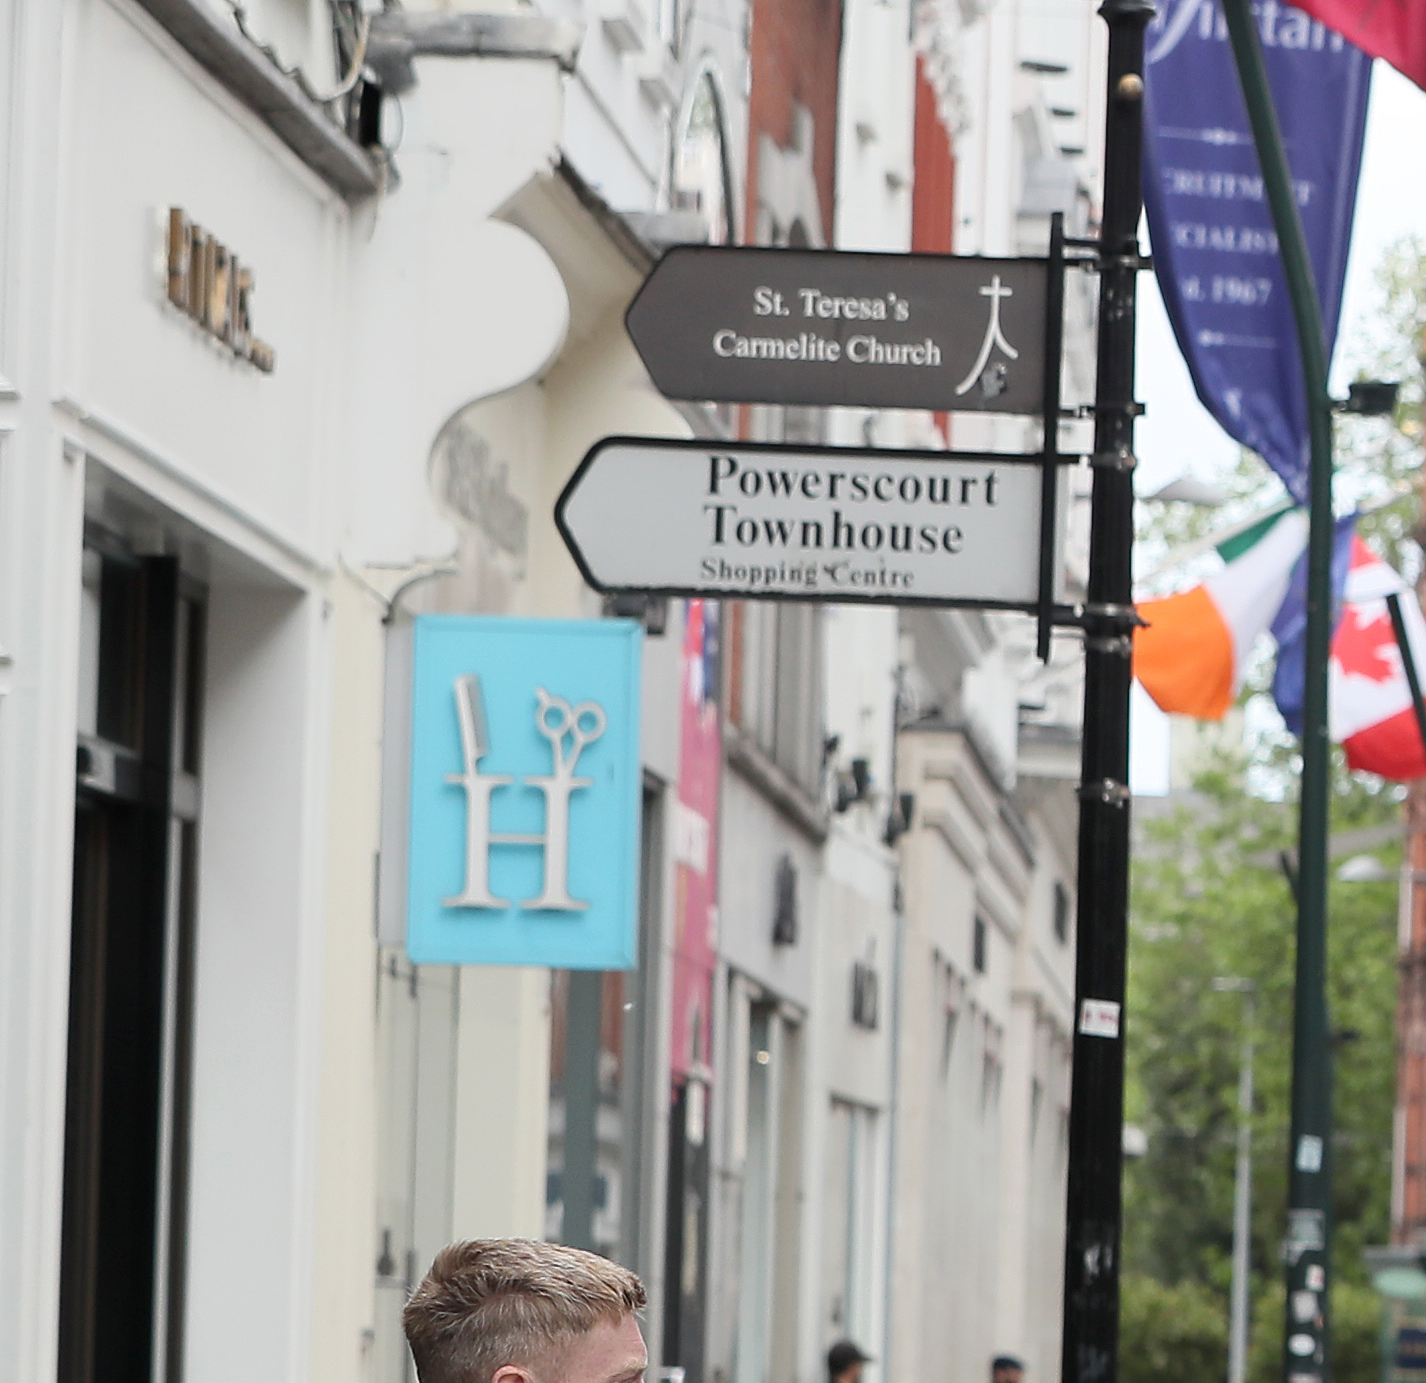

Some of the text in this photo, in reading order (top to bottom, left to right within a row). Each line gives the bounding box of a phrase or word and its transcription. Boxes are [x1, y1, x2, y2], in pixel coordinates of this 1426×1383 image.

[752, 286, 910, 323] St. Teresa's
[711, 330, 943, 367] Carmelite Church
[707, 455, 999, 506] Powerscourt
[704, 506, 964, 555] Townhouse
[700, 558, 917, 590] Shopping Centre
